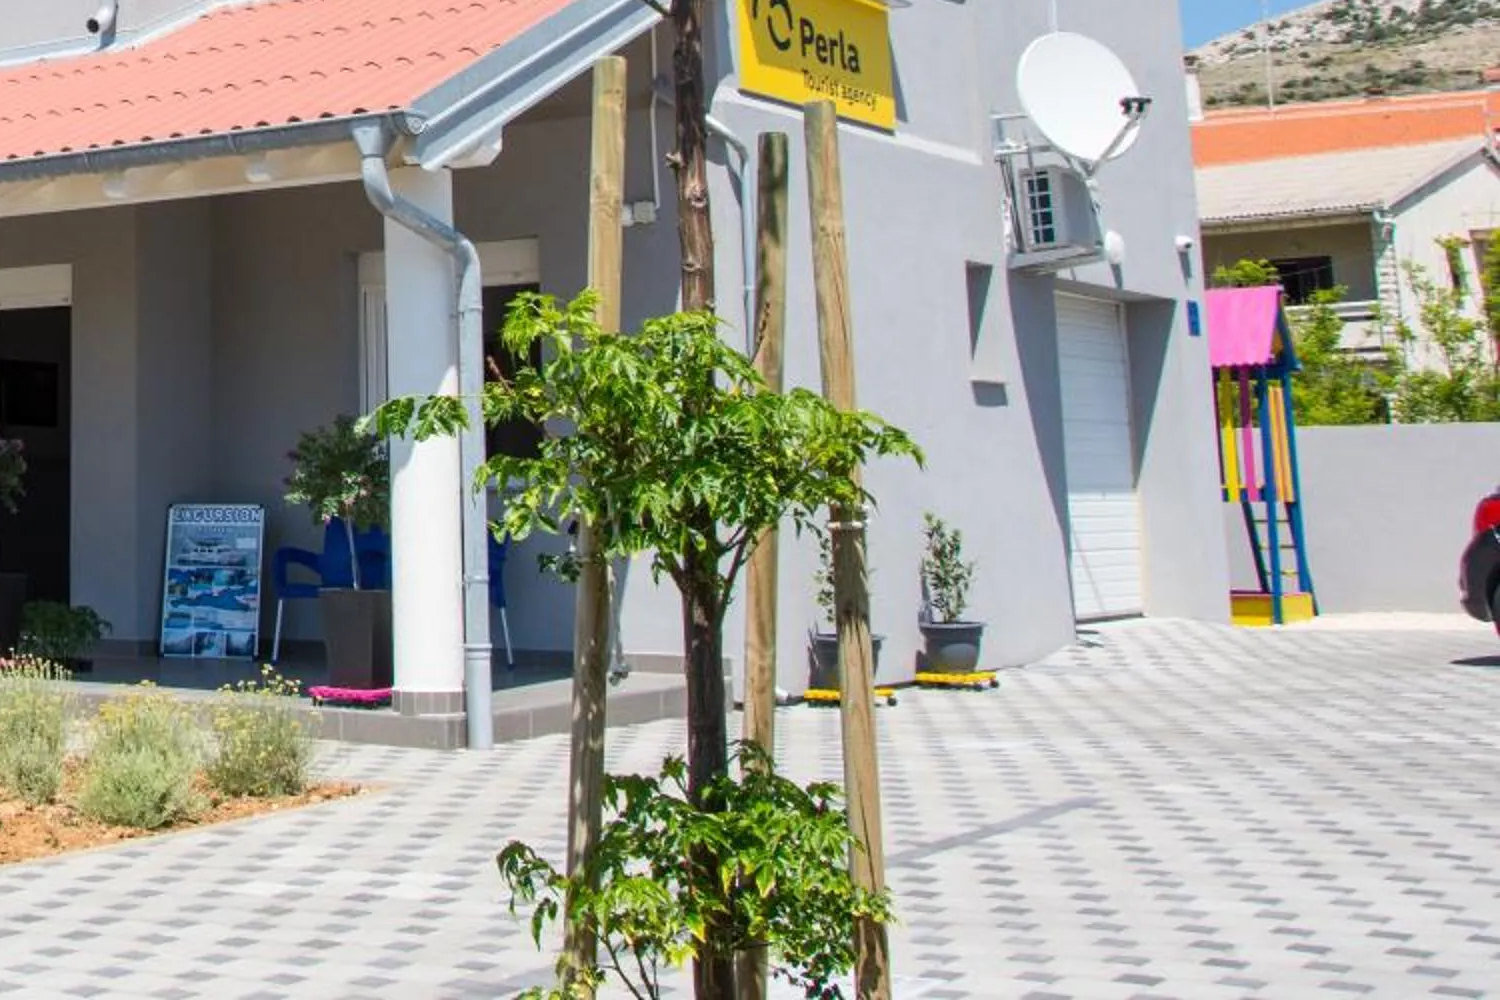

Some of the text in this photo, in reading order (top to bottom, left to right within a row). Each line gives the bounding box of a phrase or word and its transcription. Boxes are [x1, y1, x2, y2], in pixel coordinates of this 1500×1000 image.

[800, 18, 861, 73] Perla
[802, 69, 877, 111] Tourist agency
